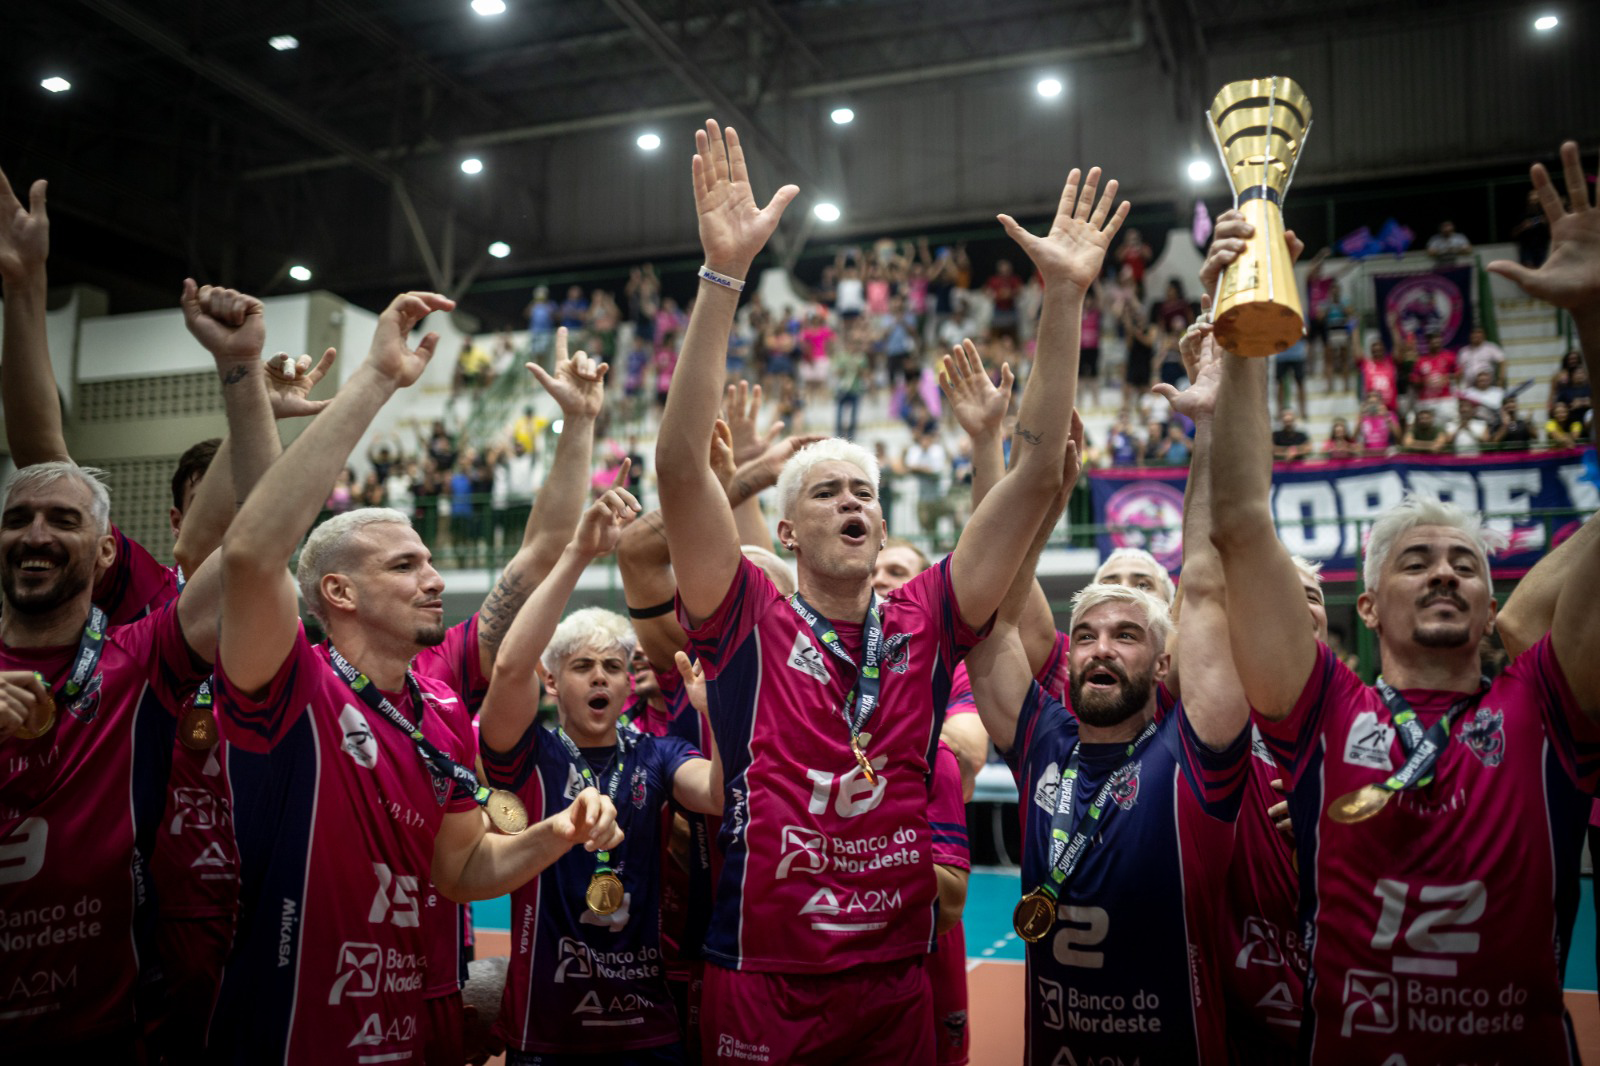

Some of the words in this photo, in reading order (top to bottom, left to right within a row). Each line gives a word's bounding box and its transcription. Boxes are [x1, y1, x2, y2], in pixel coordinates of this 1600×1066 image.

[866, 627, 881, 667] SUPERLIGA
[1396, 739, 1439, 784] SUPERLIGA
[806, 753, 889, 818] 16
[1057, 778, 1074, 815] SUPERLIGA
[832, 834, 889, 855] Banco
[892, 825, 918, 845] do
[1058, 832, 1088, 874] SUPERLIGA
[832, 848, 921, 874] Nordeste
[72, 894, 102, 918] do
[846, 888, 903, 914] A2M
[1369, 877, 1488, 955] 12
[1052, 904, 1111, 970] 2
[590, 947, 634, 965] Banco
[636, 945, 658, 962] do
[7, 964, 78, 1001] A2M
[595, 963, 660, 981] Nordeste
[1067, 986, 1126, 1011] Banco
[1131, 988, 1160, 1010] do
[1407, 979, 1489, 1007] Banco
[1498, 982, 1529, 1007] do
[1067, 1011, 1162, 1034] Nordeste
[1407, 1007, 1526, 1036] Nordeste
[734, 1049, 770, 1063] Nordeste
[735, 1039, 758, 1052] Banco
[759, 1043, 770, 1054] do
